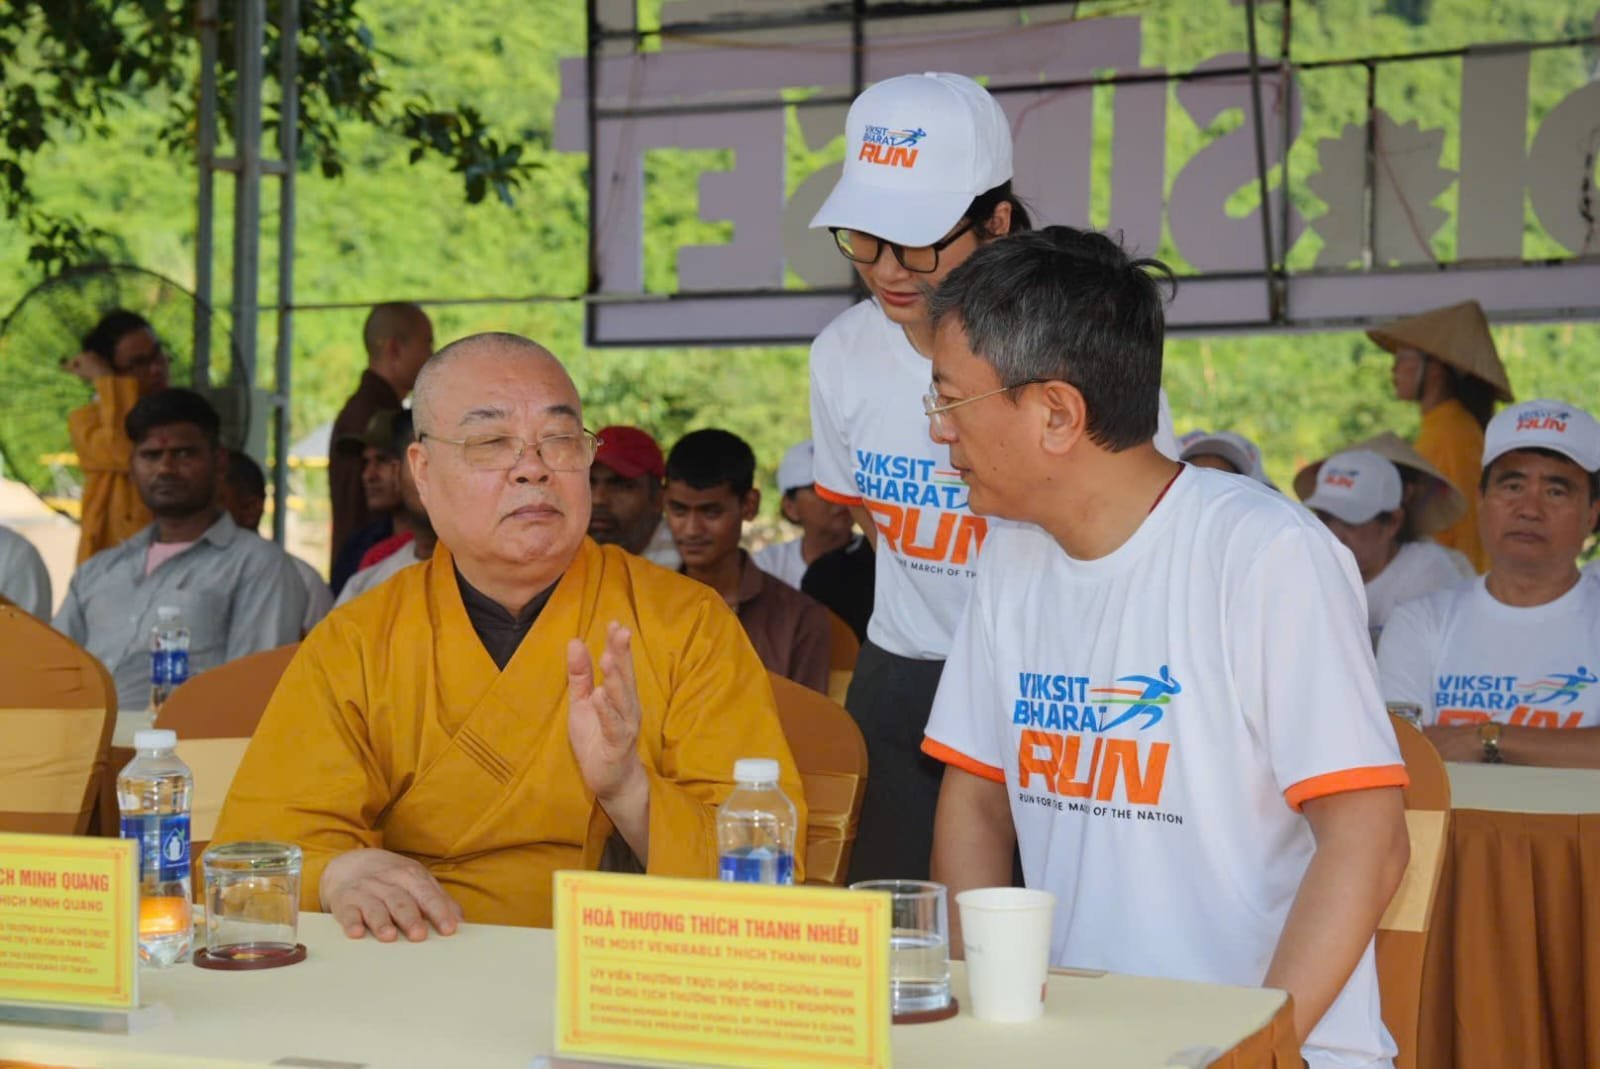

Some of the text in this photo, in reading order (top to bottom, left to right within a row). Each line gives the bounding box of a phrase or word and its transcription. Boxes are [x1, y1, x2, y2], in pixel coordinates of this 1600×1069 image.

[859, 142, 919, 168] RUN
[857, 450, 936, 481] VIKSIT
[855, 472, 962, 509] BHARAT
[911, 562, 943, 575] MARCH
[947, 568, 960, 577] OF
[1019, 672, 1090, 703] VIKSIT
[1438, 674, 1518, 692] VIKSIT
[1019, 729, 1171, 806] RUN
[1019, 793, 1034, 804] RUN
[1036, 797, 1052, 808] FOR
[1093, 806, 1109, 817] OF
[1112, 809, 1132, 820] THE
[1137, 812, 1184, 825] NATION
[19, 869, 57, 889] MINH
[62, 871, 111, 893] QUANG
[30, 896, 60, 909] MINH
[63, 897, 104, 912] QUANG
[582, 904, 615, 929] HOÀ
[690, 911, 740, 938] THÍCH
[745, 917, 802, 942] THANH
[583, 935, 606, 949] THE
[610, 938, 644, 952] MOST
[648, 942, 722, 958] VENERABLE
[726, 945, 767, 960] THICH
[771, 949, 818, 964] THANH
